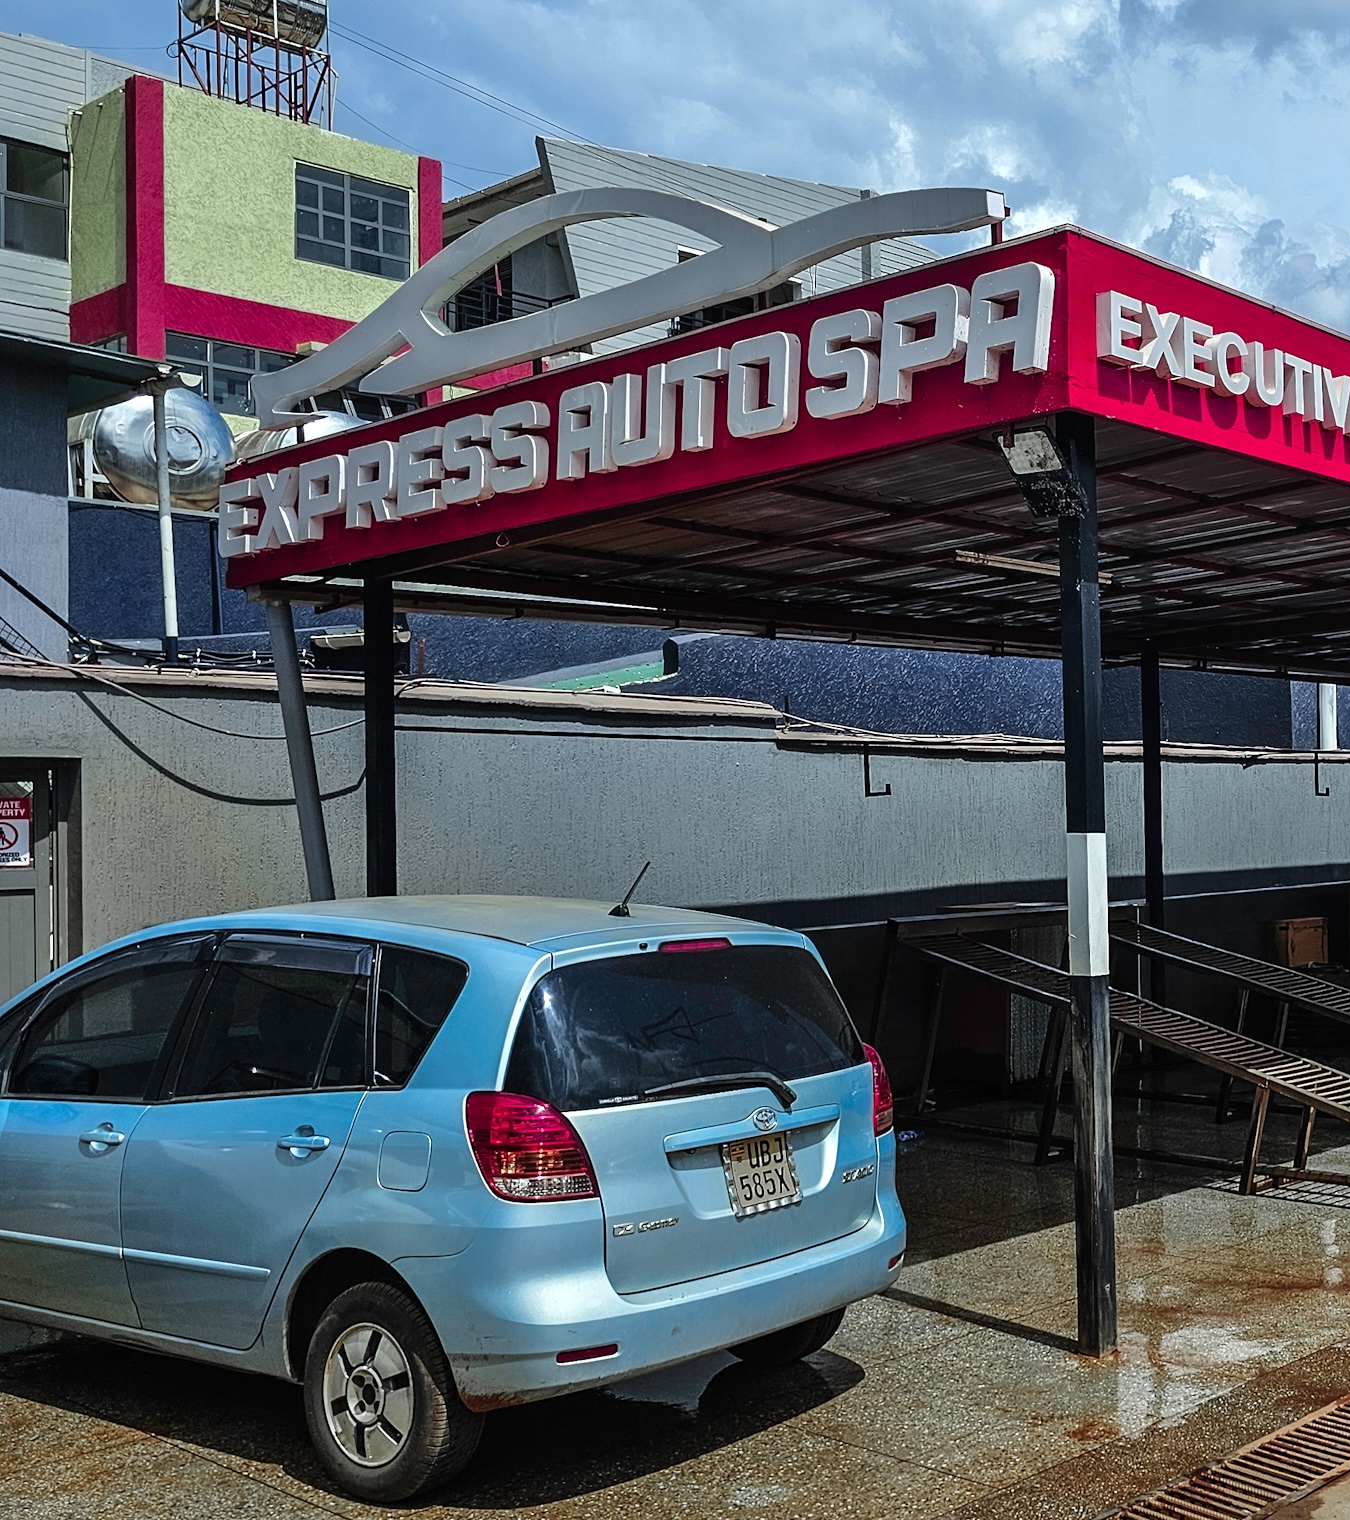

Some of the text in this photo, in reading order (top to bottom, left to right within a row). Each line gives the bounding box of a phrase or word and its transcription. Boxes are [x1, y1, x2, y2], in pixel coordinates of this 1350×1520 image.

[219, 261, 1056, 558] EXPRESS AUTO SPA
[747, 1137, 783, 1168] UBJ
[739, 1166, 790, 1201] 585X
